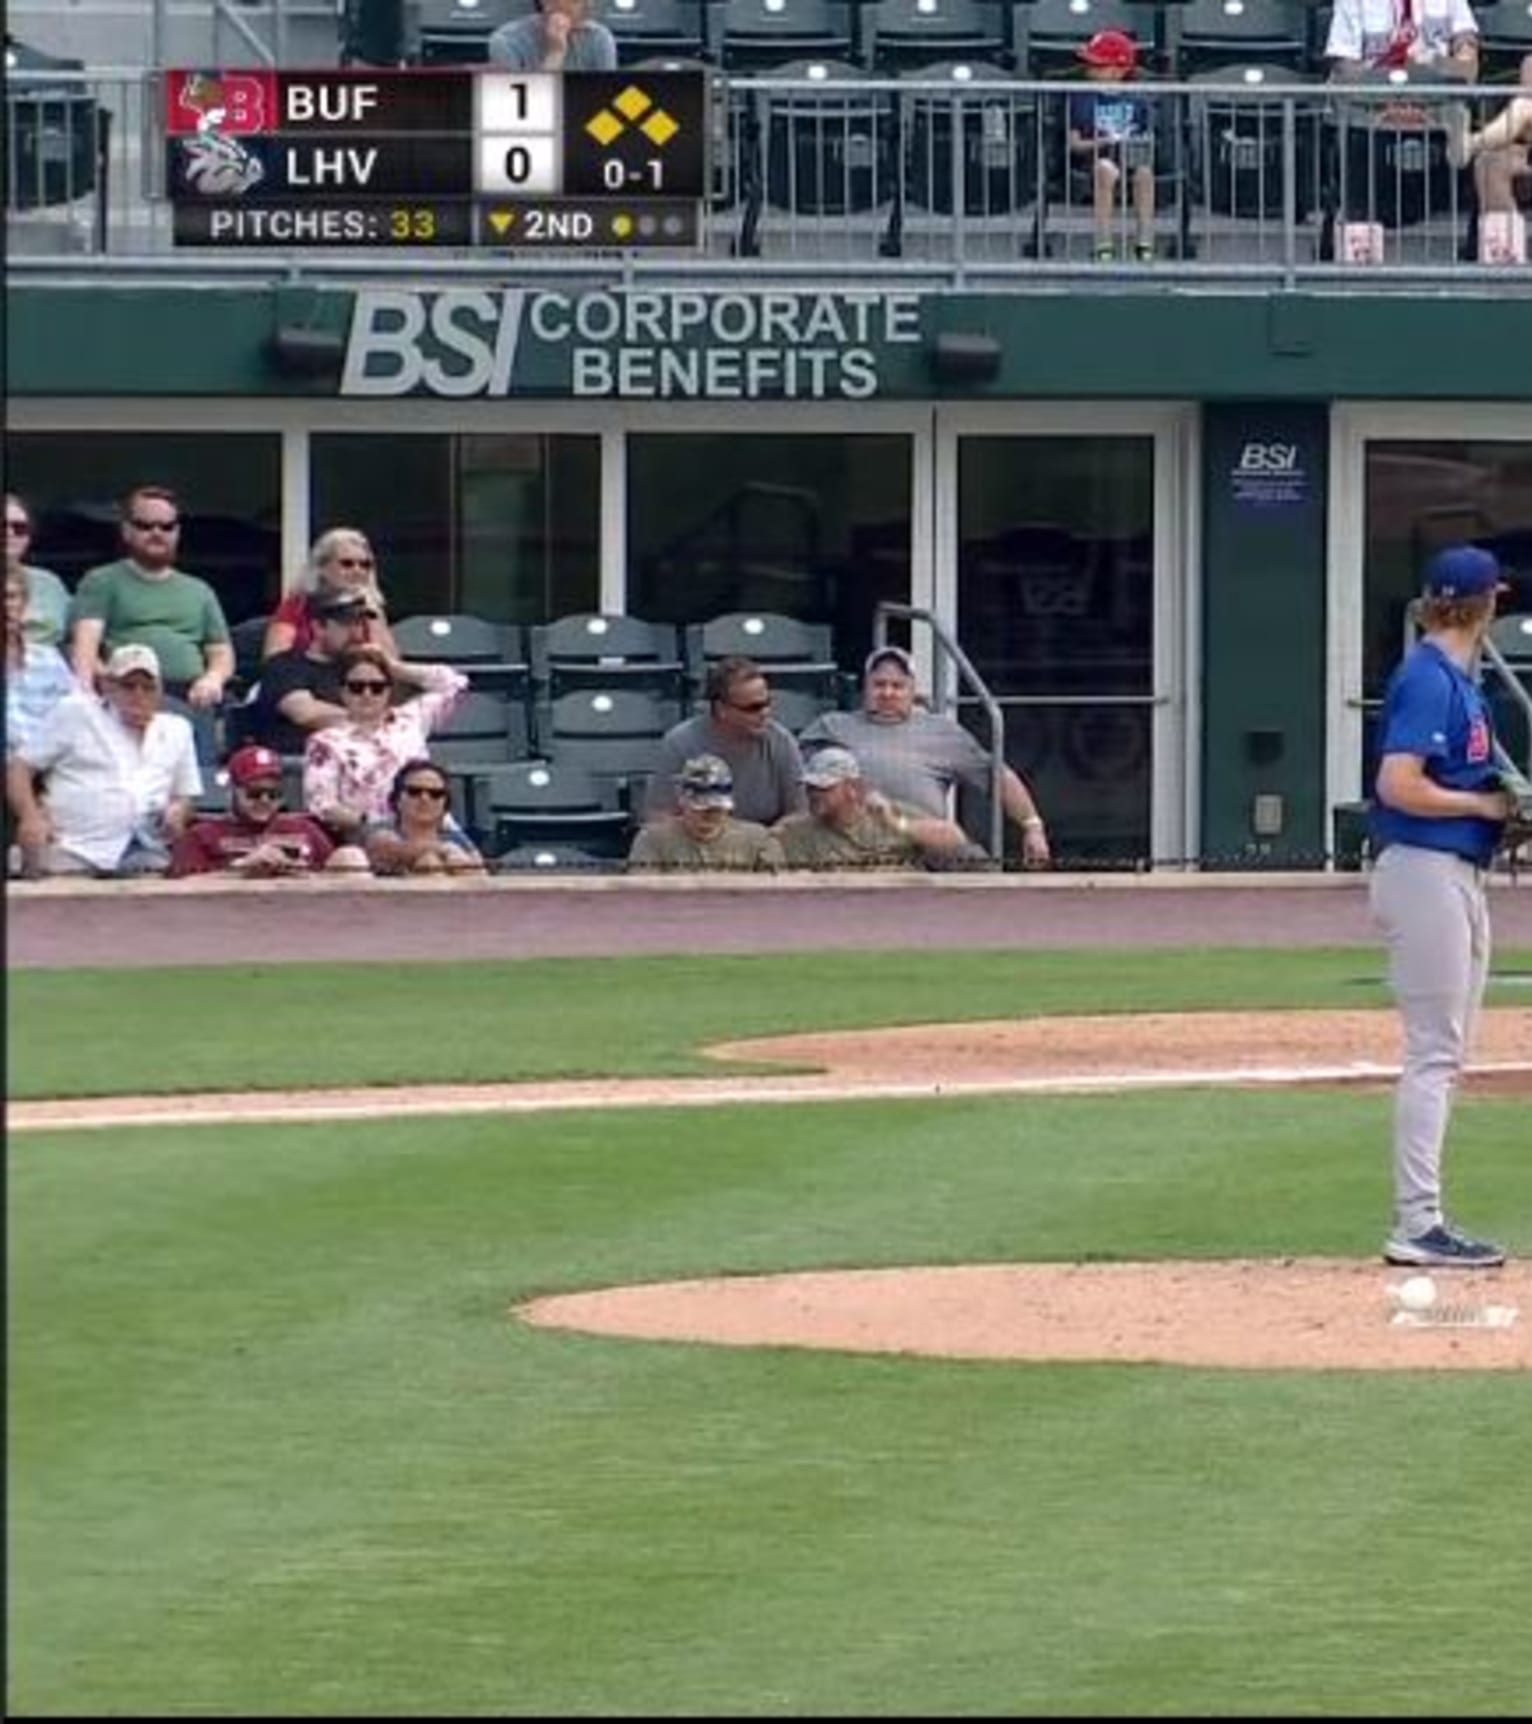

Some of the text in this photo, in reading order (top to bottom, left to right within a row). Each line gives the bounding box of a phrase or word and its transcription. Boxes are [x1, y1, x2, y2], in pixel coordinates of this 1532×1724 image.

[340, 287, 524, 397] BSI
[529, 292, 921, 343] CORPORATE
[571, 348, 879, 397] BENEFITS
[1240, 442, 1297, 470] BSI
